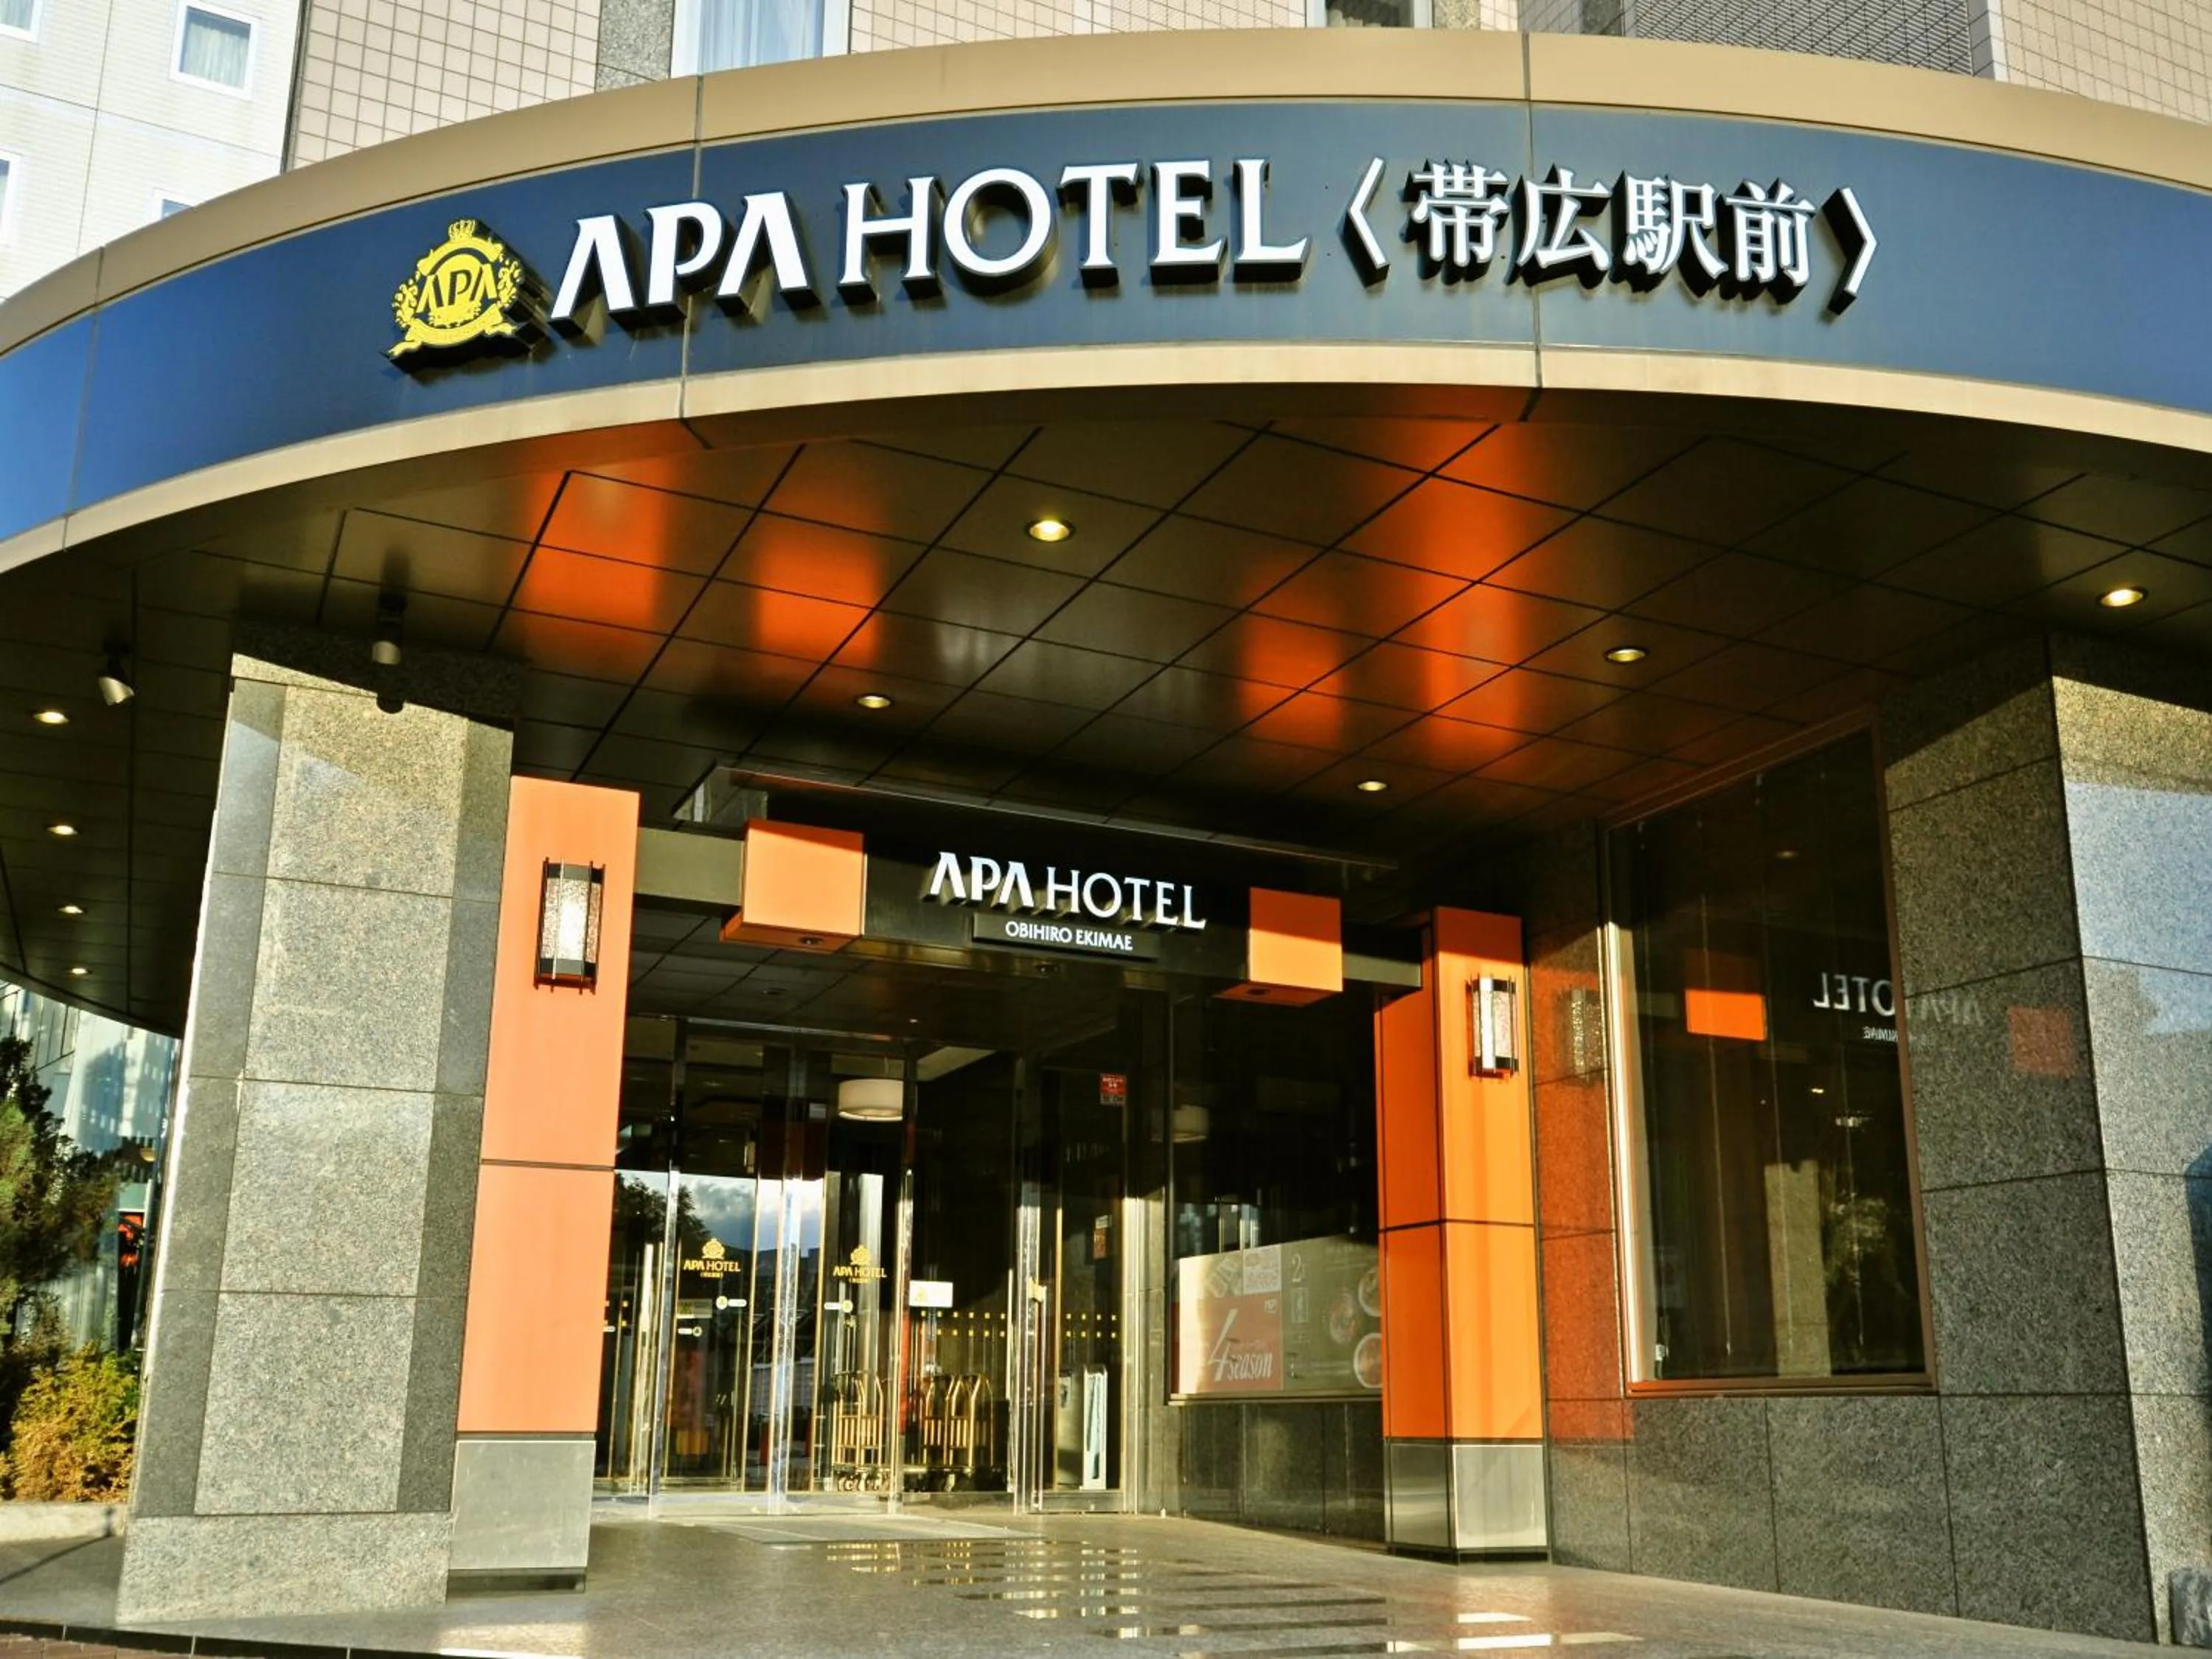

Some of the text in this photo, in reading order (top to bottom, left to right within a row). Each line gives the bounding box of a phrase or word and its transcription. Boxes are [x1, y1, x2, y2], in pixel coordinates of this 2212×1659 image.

[550, 192, 808, 319] APA
[839, 159, 1307, 285] HOTEL
[416, 263, 498, 314] APA
[929, 852, 1207, 930] APA HOTEL
[1004, 920, 1134, 951] OBIHIRO EKIMAE
[683, 1259, 741, 1273] APA HOTEL
[832, 1265, 888, 1279] APA HOTEL
